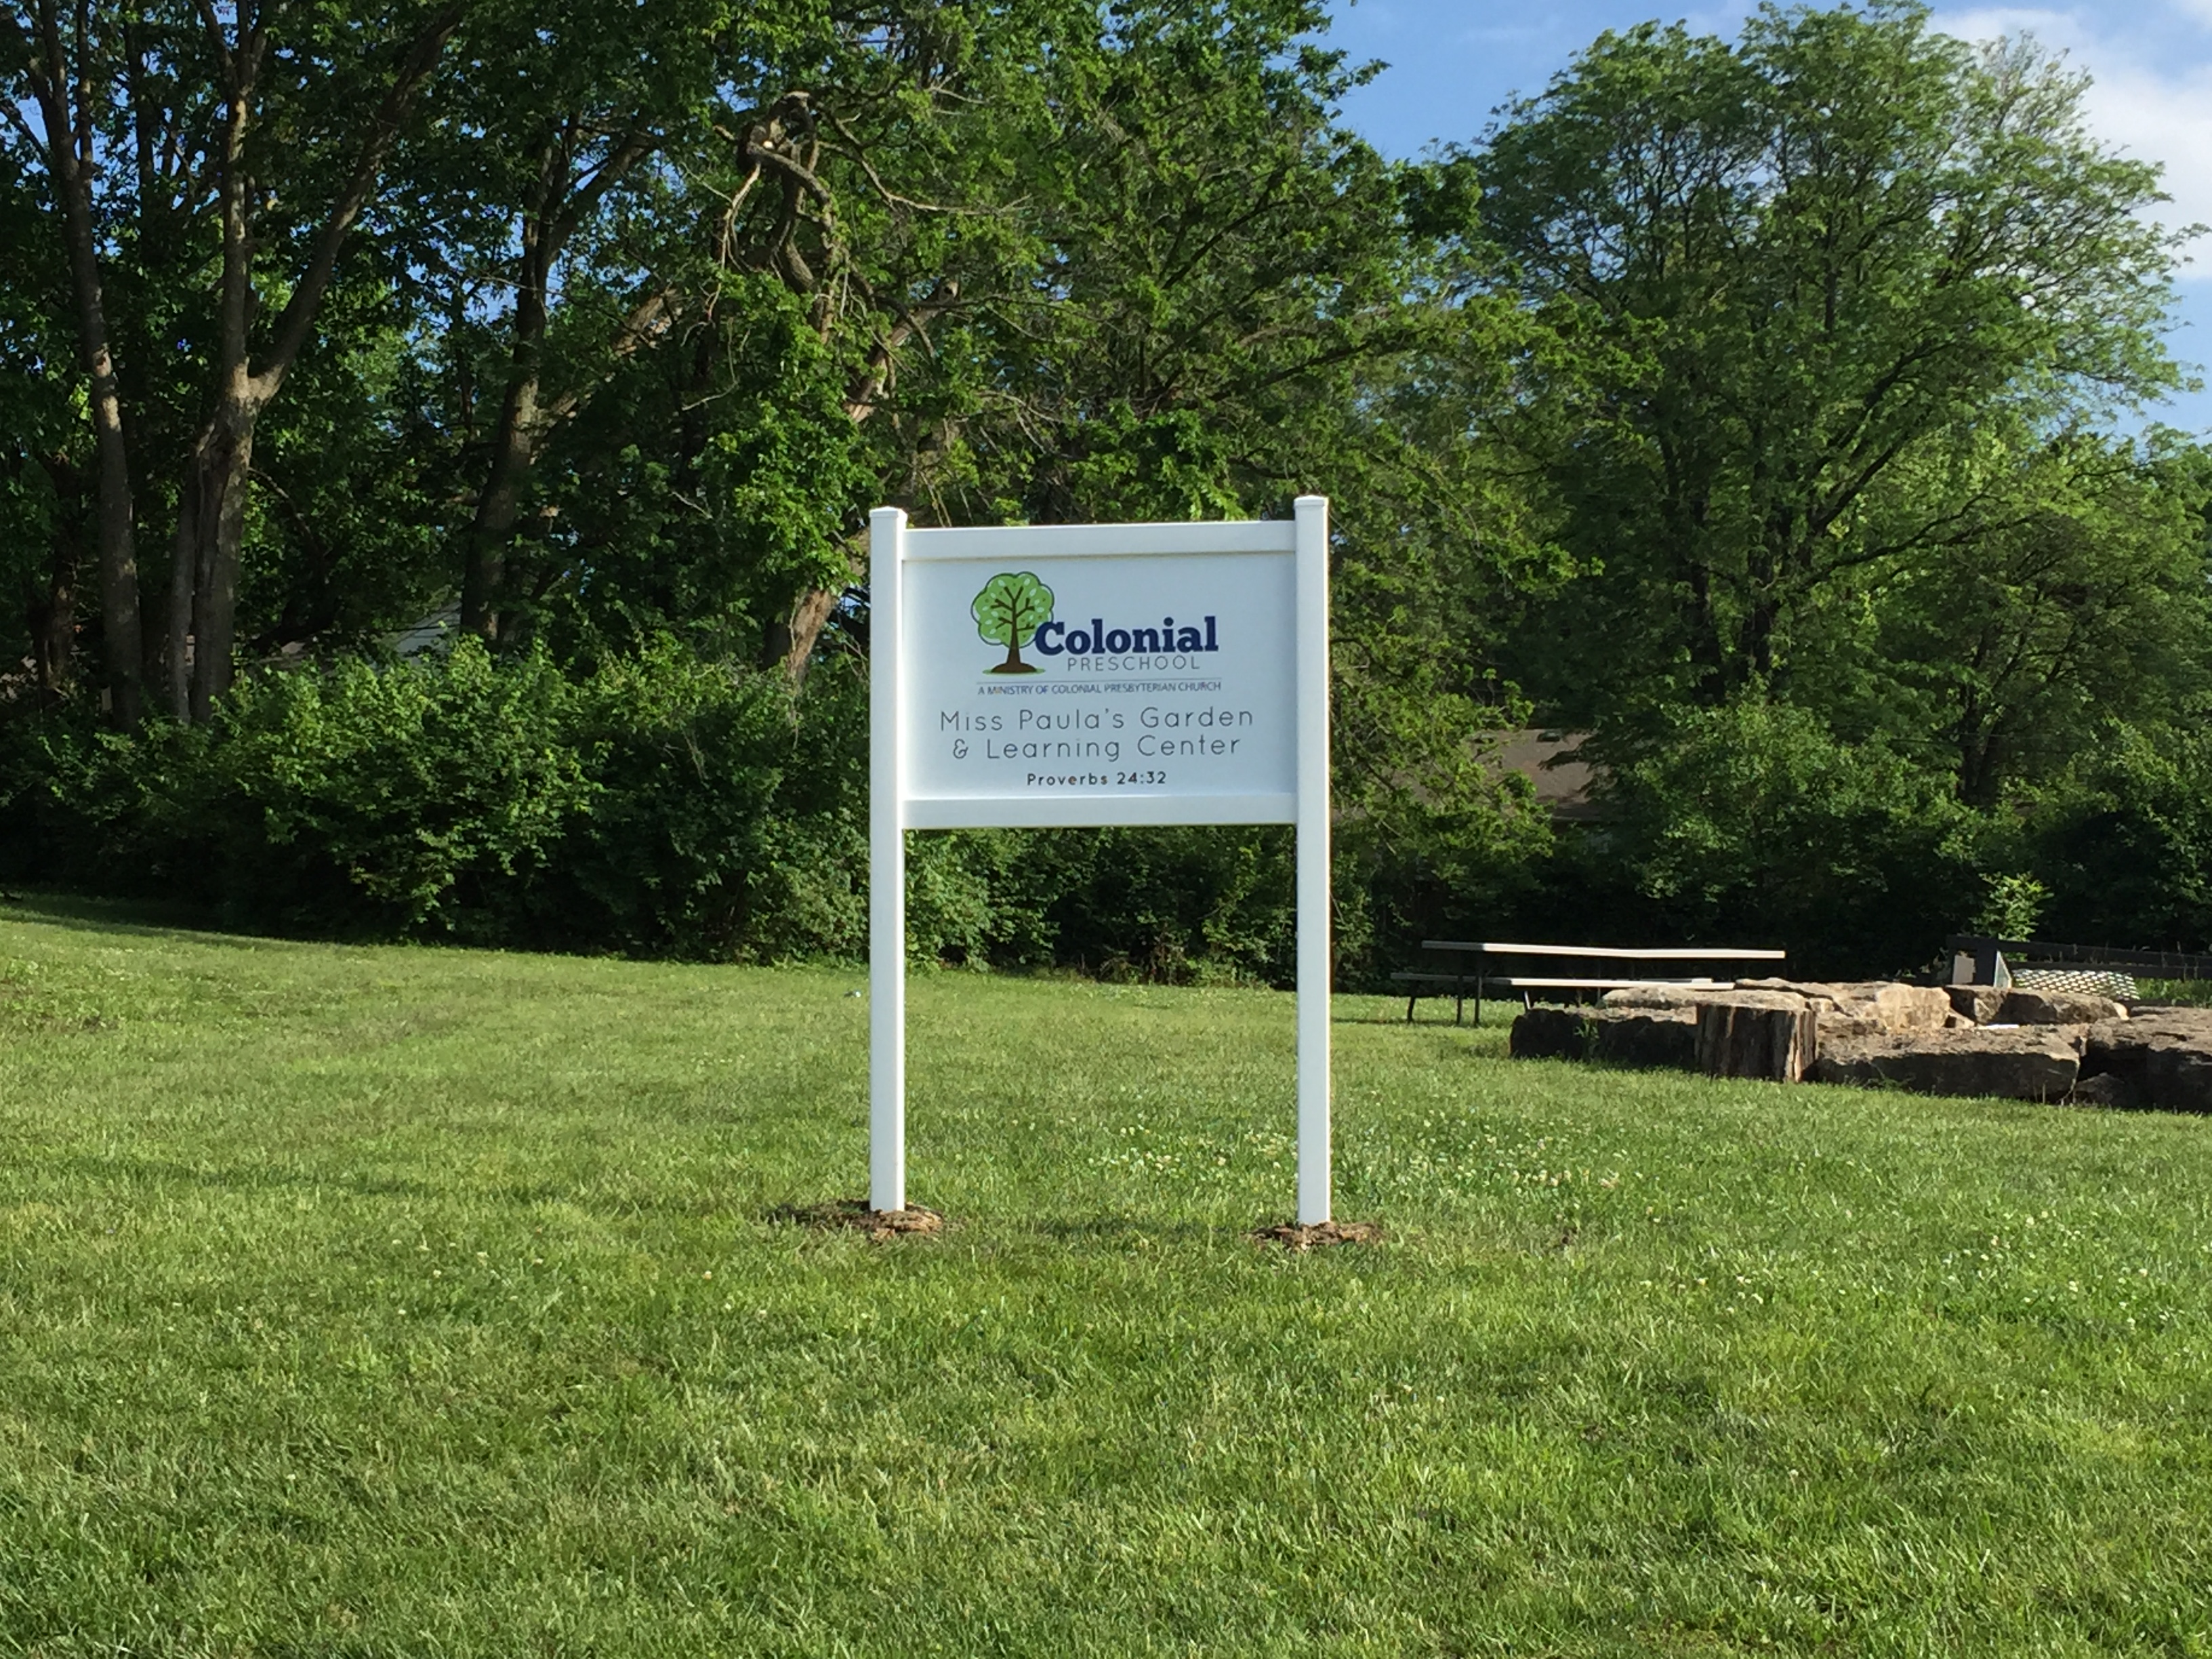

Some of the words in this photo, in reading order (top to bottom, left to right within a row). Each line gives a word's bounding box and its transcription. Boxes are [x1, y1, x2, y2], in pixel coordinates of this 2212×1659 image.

[1034, 616, 1218, 655] Colonial
[1067, 655, 1200, 672] PRESCHOOL
[977, 686, 985, 695] A
[987, 685, 1034, 695] MINISTRY
[1035, 684, 1049, 695] OF
[1050, 684, 1102, 695] COLONIAL
[1104, 682, 1176, 693] PRESBYTERIAN
[1177, 681, 1221, 692] CHURCH
[941, 710, 1003, 731] Miss
[1019, 708, 1124, 731] Paula's
[1140, 705, 1252, 729] Garden
[952, 738, 969, 760] &
[987, 739, 1120, 762] Learning
[1137, 734, 1240, 756] Center
[1027, 772, 1108, 786] Proverbs
[1117, 771, 1166, 785] 24:32
